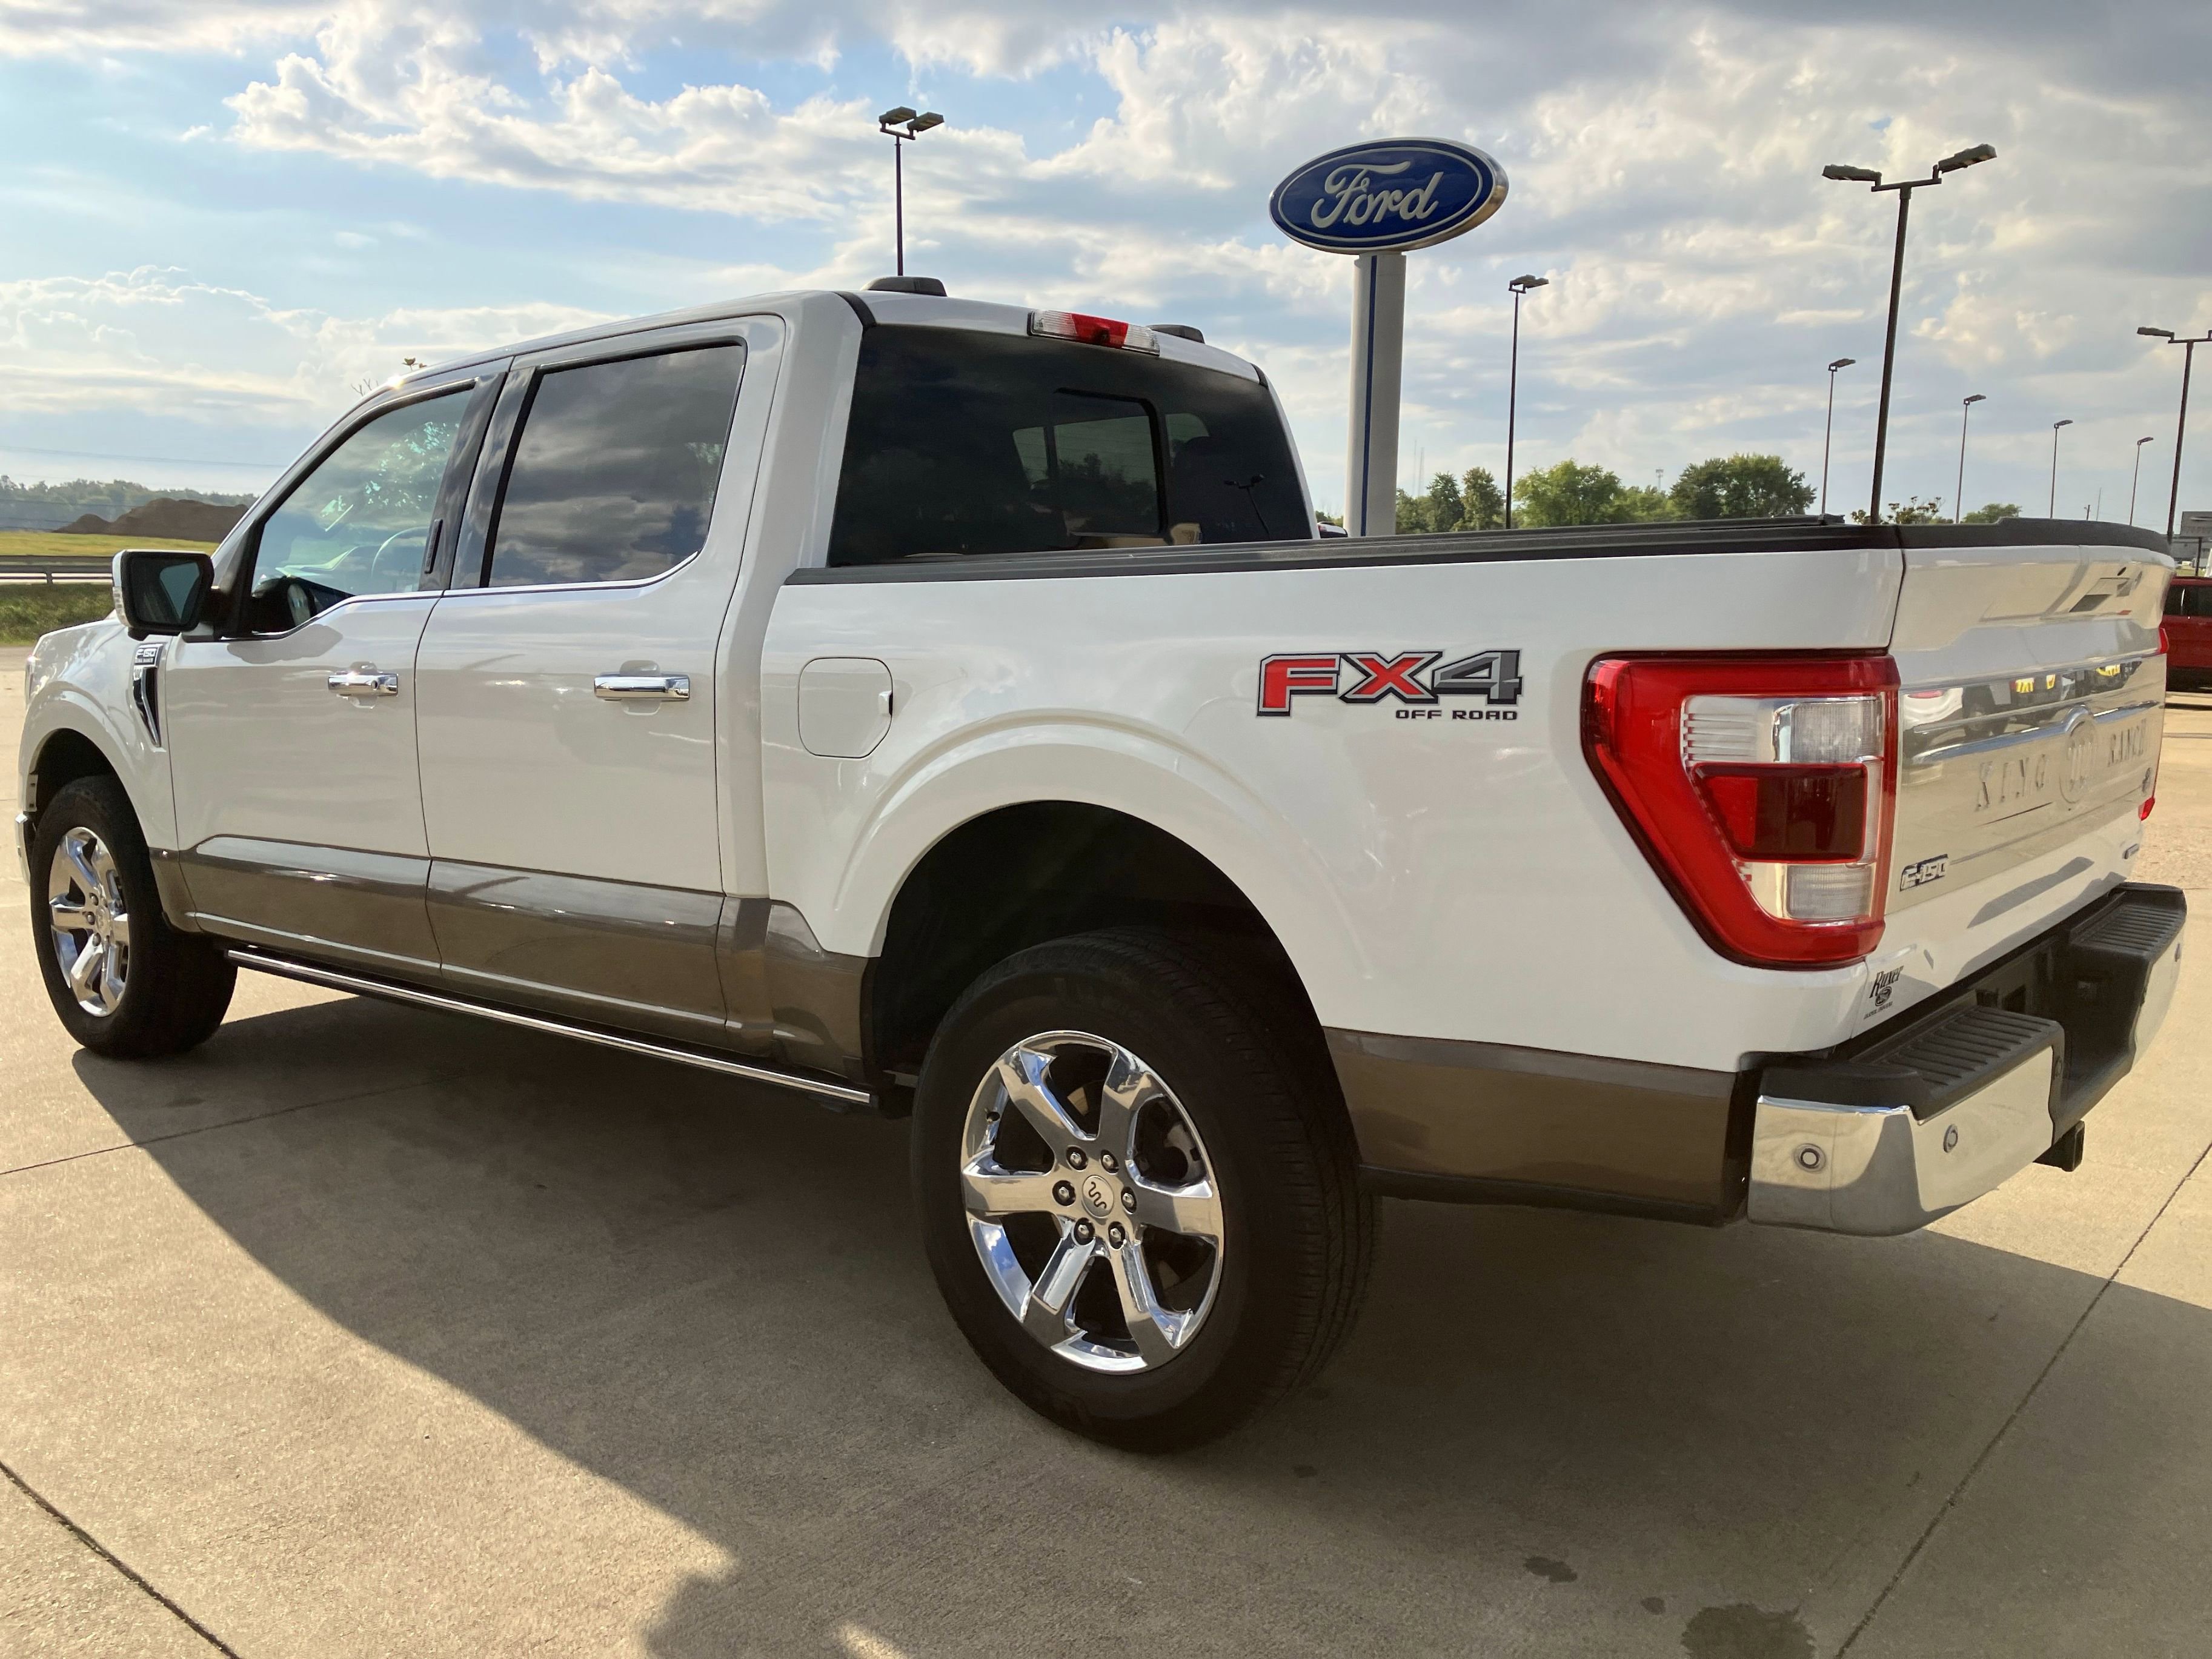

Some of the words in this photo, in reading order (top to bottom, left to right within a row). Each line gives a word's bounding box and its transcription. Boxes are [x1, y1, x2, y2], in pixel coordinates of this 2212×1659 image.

[1310, 161, 1444, 228] Ford
[1257, 650, 1523, 717] FX4
[1395, 710, 1442, 720] OFF
[1452, 710, 1518, 721] ROAD
[1899, 853, 1948, 892] F-150
